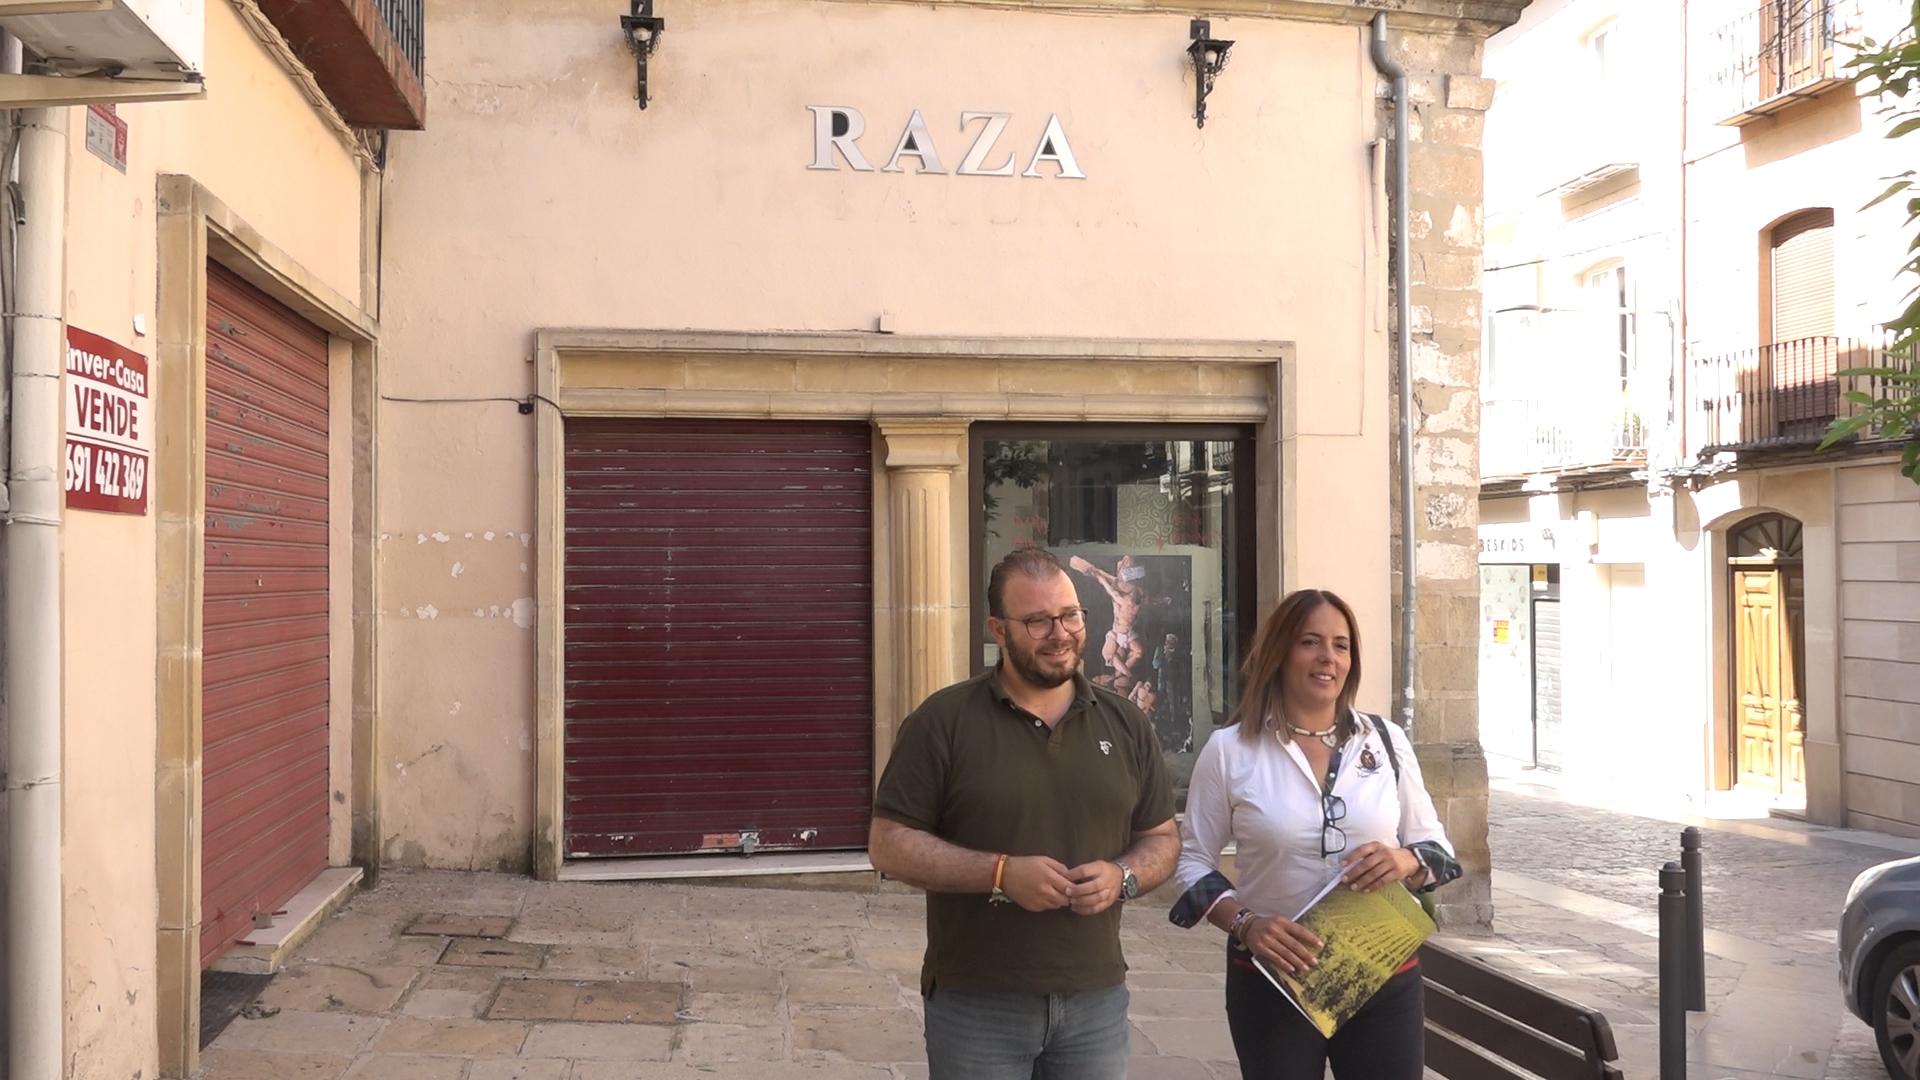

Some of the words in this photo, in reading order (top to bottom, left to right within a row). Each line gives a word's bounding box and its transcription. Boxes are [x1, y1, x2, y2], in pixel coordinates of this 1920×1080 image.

[806, 105, 1087, 179] RAZA
[74, 384, 138, 440] VENDE
[65, 443, 91, 493] 691
[95, 449, 120, 497] 422
[122, 455, 145, 500] 369
